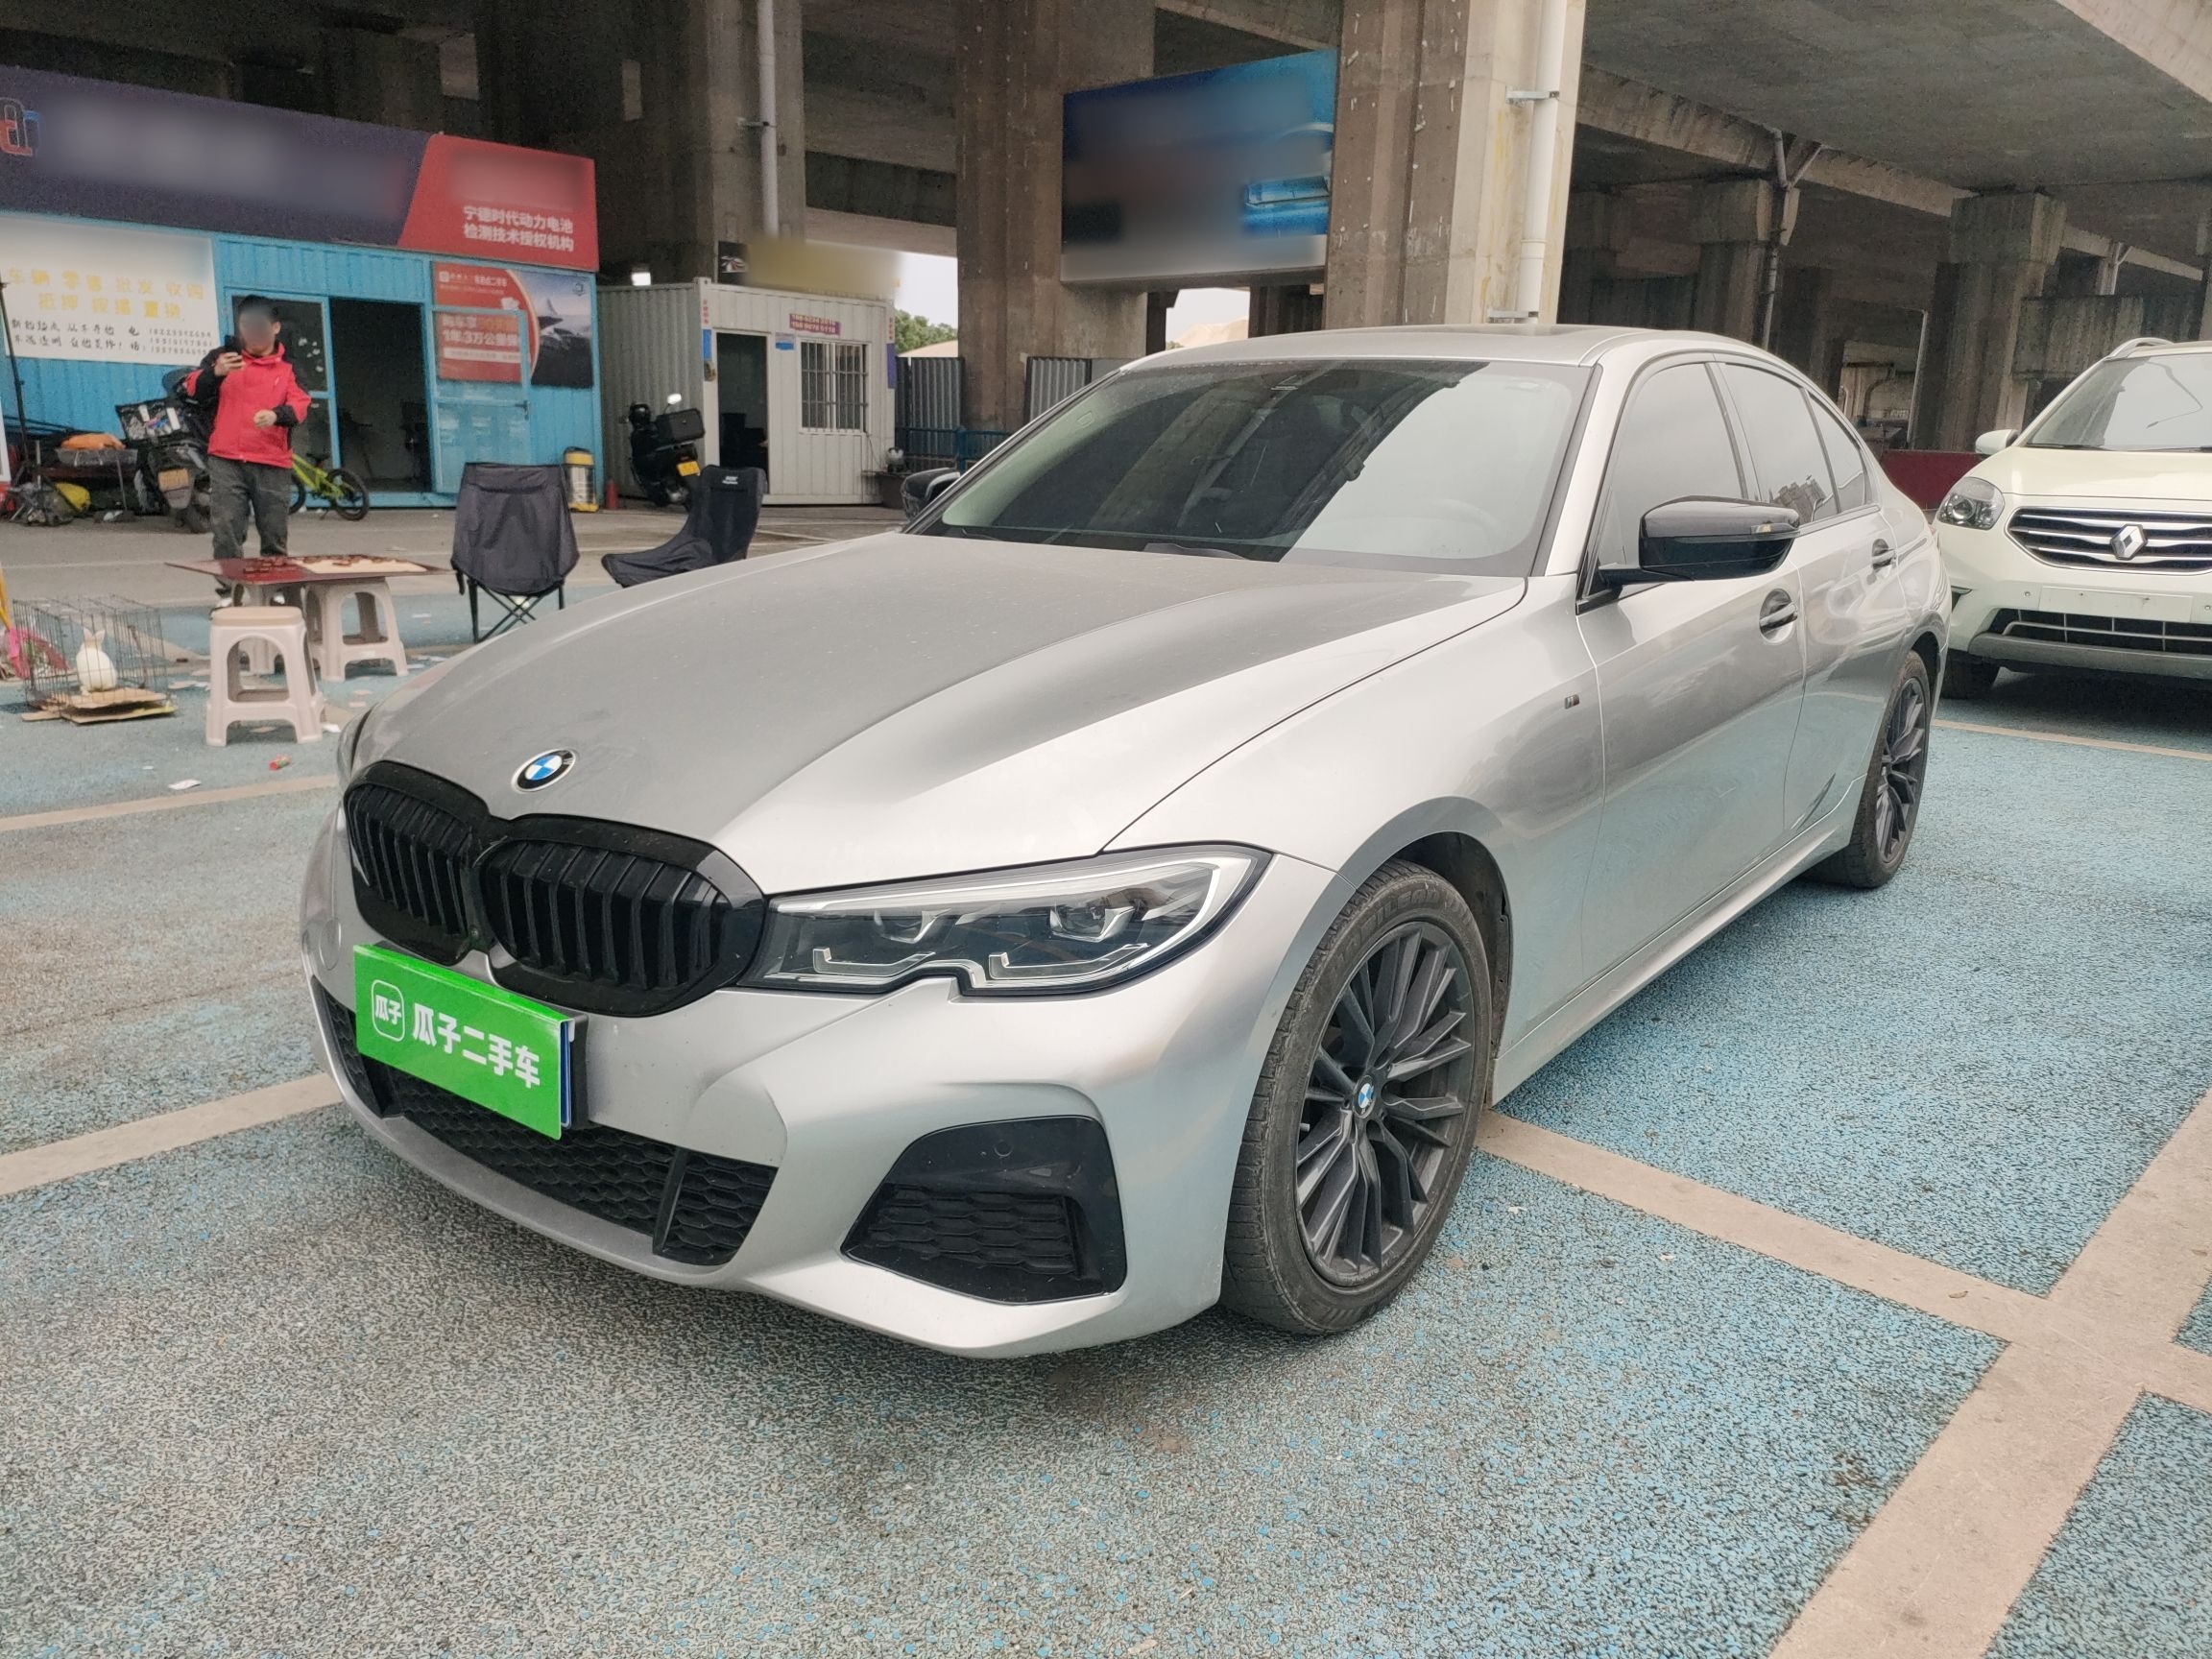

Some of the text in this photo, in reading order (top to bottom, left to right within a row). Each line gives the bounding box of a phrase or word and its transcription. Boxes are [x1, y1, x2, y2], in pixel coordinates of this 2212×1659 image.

[464, 204, 573, 234] 宁德时代动力电池
[464, 223, 574, 252] 检测技术授权机构
[374, 994, 541, 1090] 瓜子 瓜子二手车
